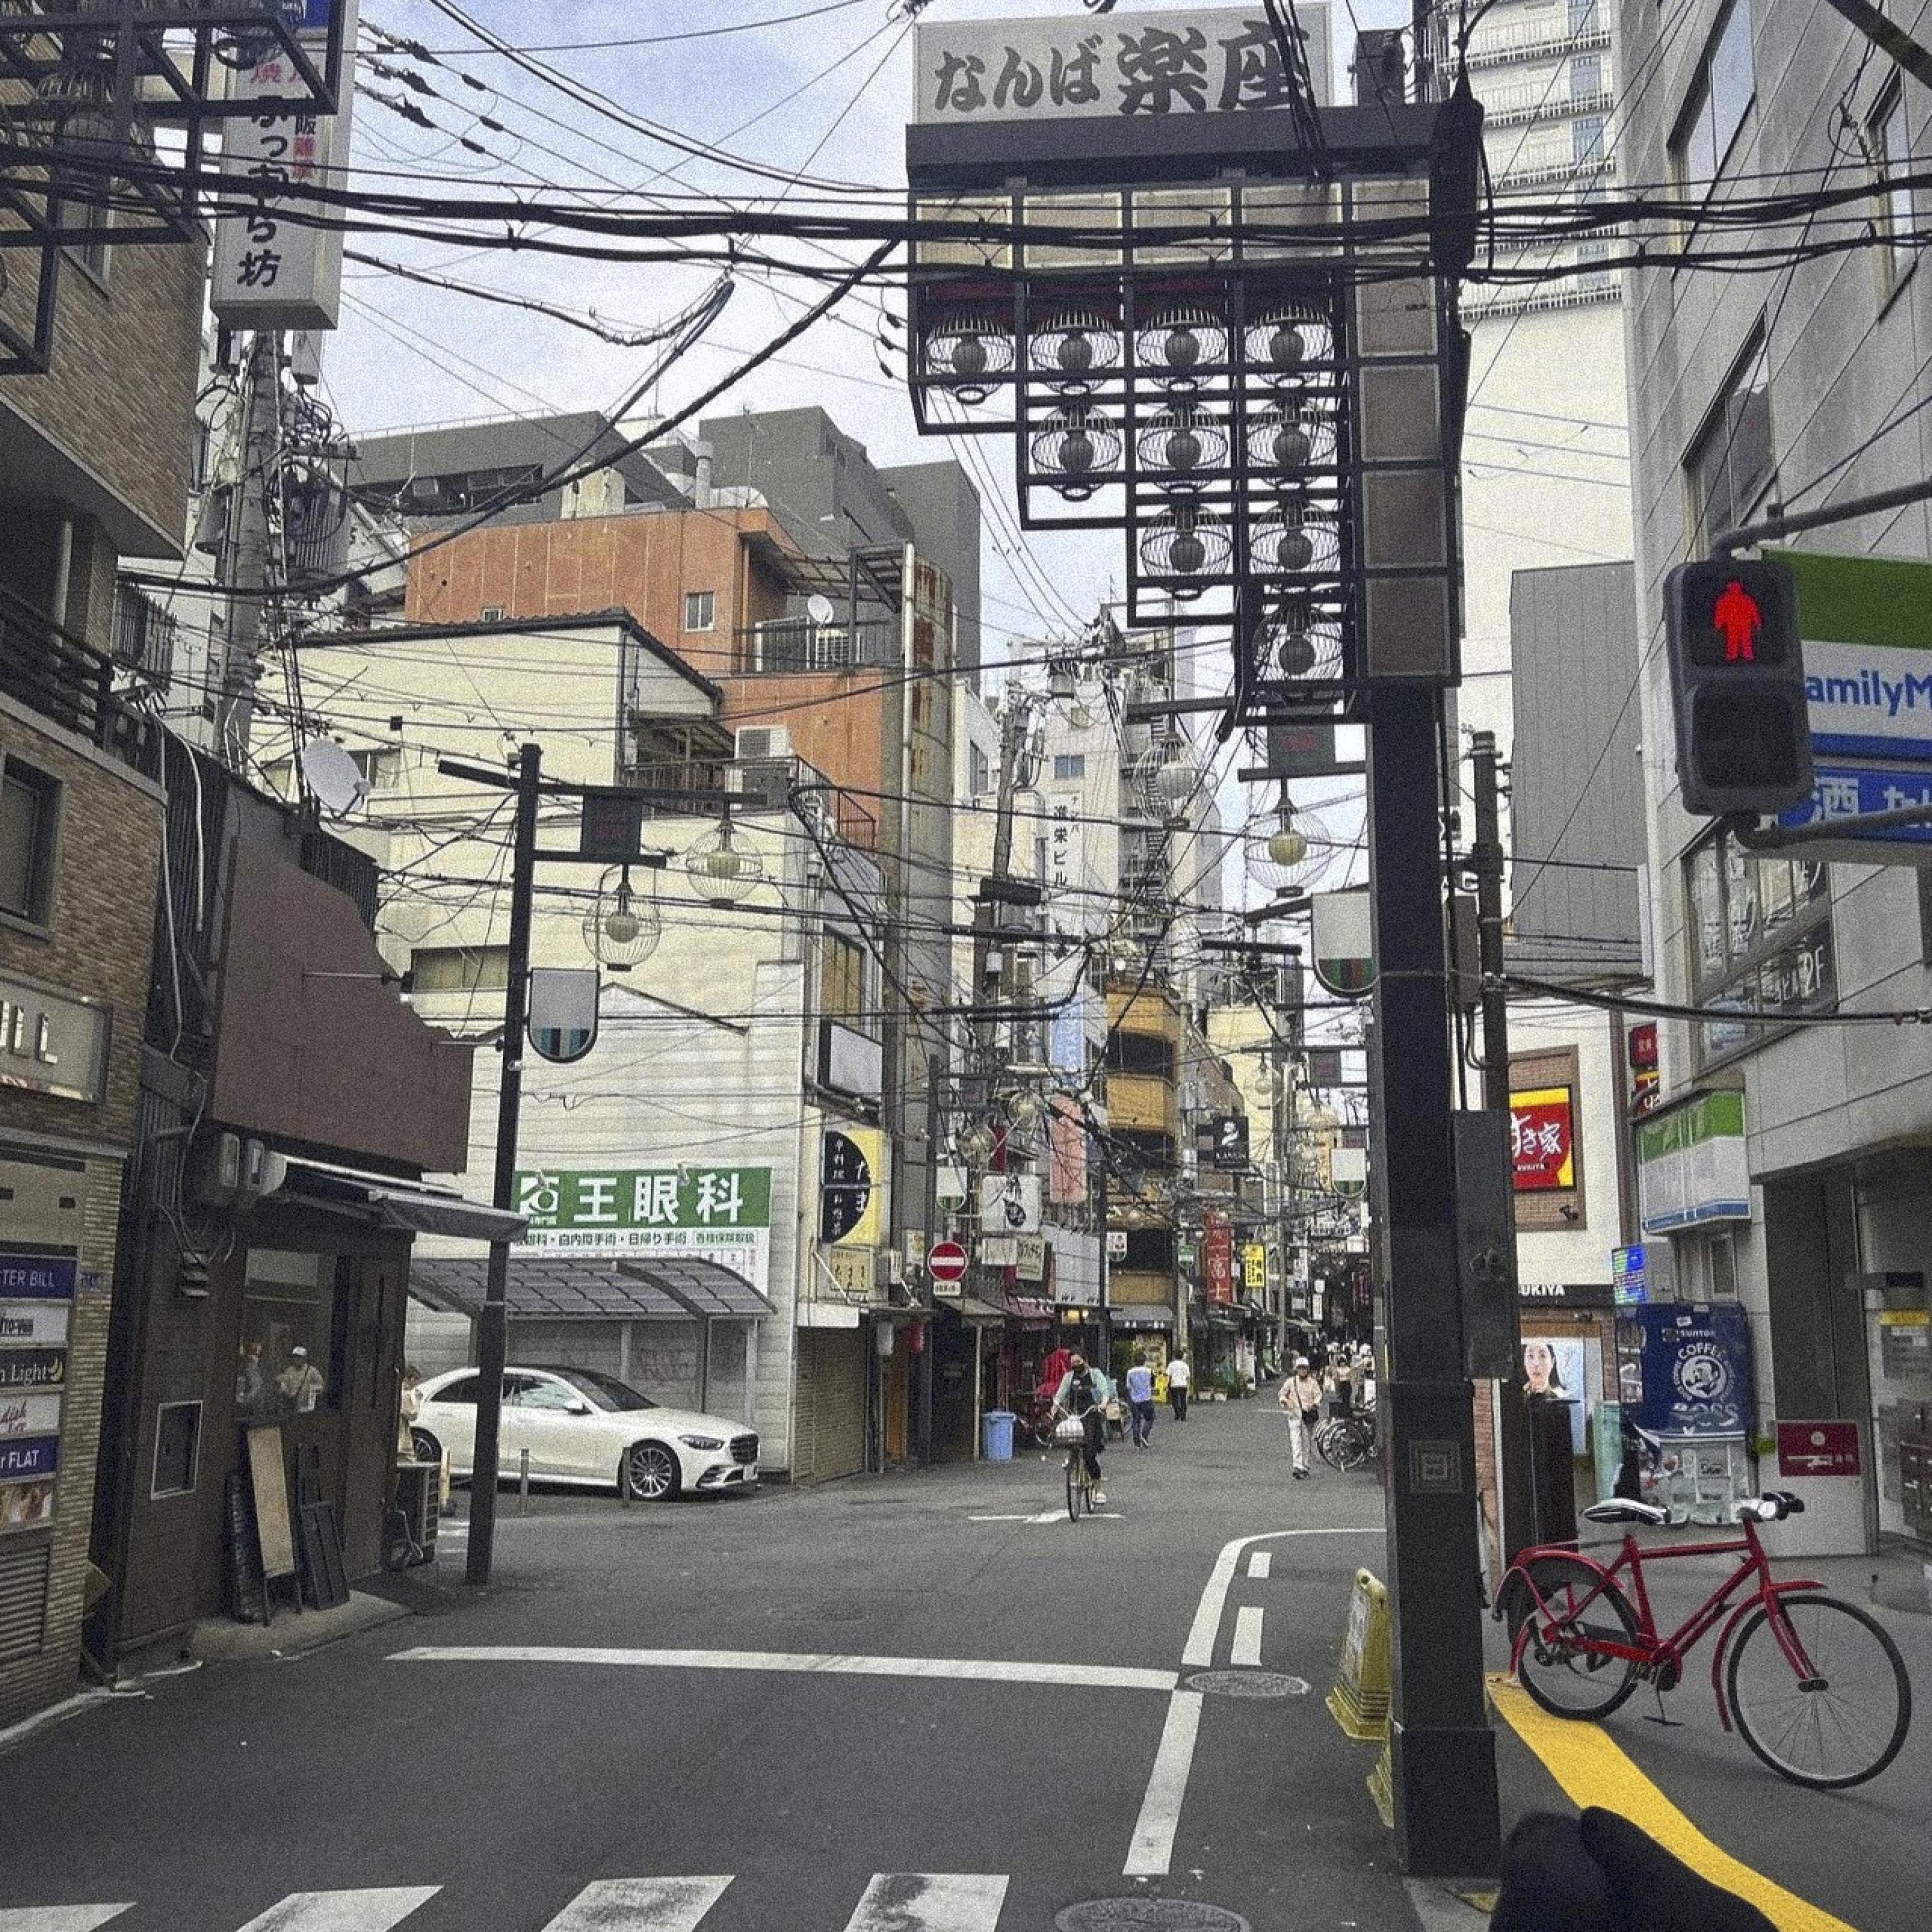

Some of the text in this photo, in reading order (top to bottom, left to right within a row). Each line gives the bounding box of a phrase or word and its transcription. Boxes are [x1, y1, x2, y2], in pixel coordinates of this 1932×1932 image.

[934, 20, 1310, 115] なんば楽座
[573, 1173, 743, 1224] 王眼科
[30, 1269, 55, 1287] BILL
[10, 1362, 46, 1386] Light
[8, 1449, 40, 1469] FLAT
